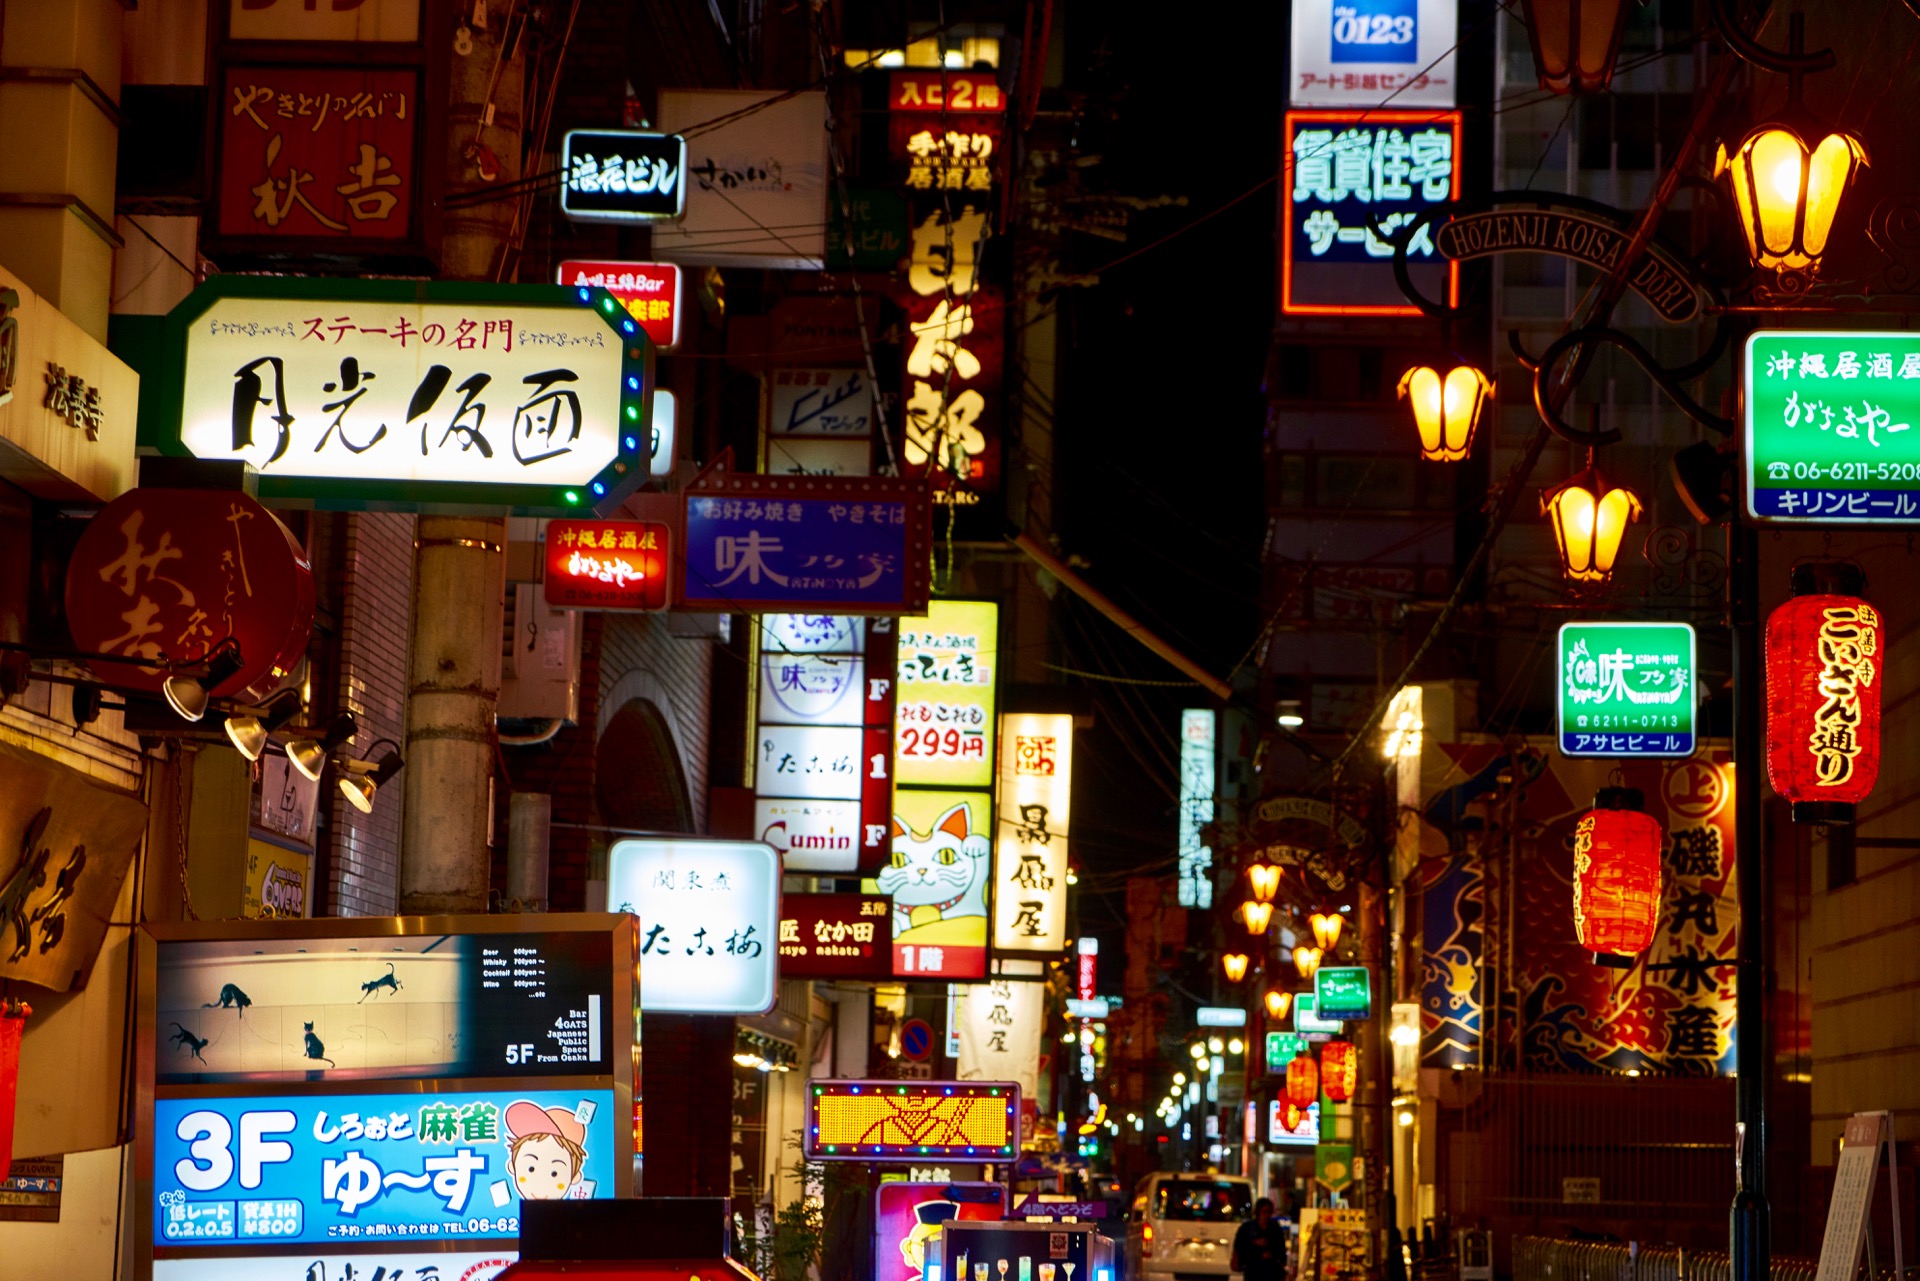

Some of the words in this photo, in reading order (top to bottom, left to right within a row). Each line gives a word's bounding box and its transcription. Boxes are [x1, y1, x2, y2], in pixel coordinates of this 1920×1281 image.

[1333, 15, 1415, 44] 0123
[900, 79, 1000, 108] 入口2階
[1300, 72, 1448, 91] アート引越センター
[232, 85, 407, 132] やきとりの名門
[906, 130, 993, 158] 手作り
[912, 157, 987, 167] KODWARI
[1293, 128, 1452, 203] 賃貸住宅
[252, 133, 402, 232] 秋吉
[569, 153, 678, 196] 浪花ビル
[905, 166, 992, 190] 居酒屋
[1303, 210, 1435, 257] サービス
[1553, 220, 1624, 268] KOISA
[617, 297, 671, 321] 楽部
[301, 316, 513, 352] ステーキの名門
[1765, 349, 1920, 380] 沖縄居酒屋
[231, 356, 583, 470] 月光仮面
[703, 502, 804, 522] お好み焼き
[1778, 490, 1917, 515] キリンビール
[557, 527, 658, 550] 沖縄居酒屋
[1857, 604, 1879, 687] 法善寺
[868, 678, 890, 700] F
[1809, 607, 1863, 786] こいさん通り
[1594, 715, 1678, 727] 6211-0713
[901, 728, 984, 757] 299円
[1575, 734, 1680, 751] アサヒビール
[761, 820, 851, 854] Cumin
[859, 902, 888, 916] 五階
[814, 919, 875, 943] なか田
[1668, 825, 1725, 1057] 磯丸水産
[816, 945, 860, 957] nakata
[901, 945, 944, 972] 1階
[569, 1009, 588, 1018] Bar
[547, 1030, 588, 1040] Japanese
[558, 1038, 588, 1046] Public
[506, 1043, 535, 1064] 5F
[537, 1055, 558, 1063] From
[560, 1054, 588, 1062] Osaka
[562, 1046, 588, 1055] Space
[173, 1110, 299, 1192] 3F
[159, 1189, 186, 1206] 安心
[1021, 1202, 1094, 1216] 4階へどうぞ
[169, 1204, 230, 1222] 低レート
[166, 1220, 233, 1238] 0.2&0.5
[243, 1218, 298, 1236] ¥800
